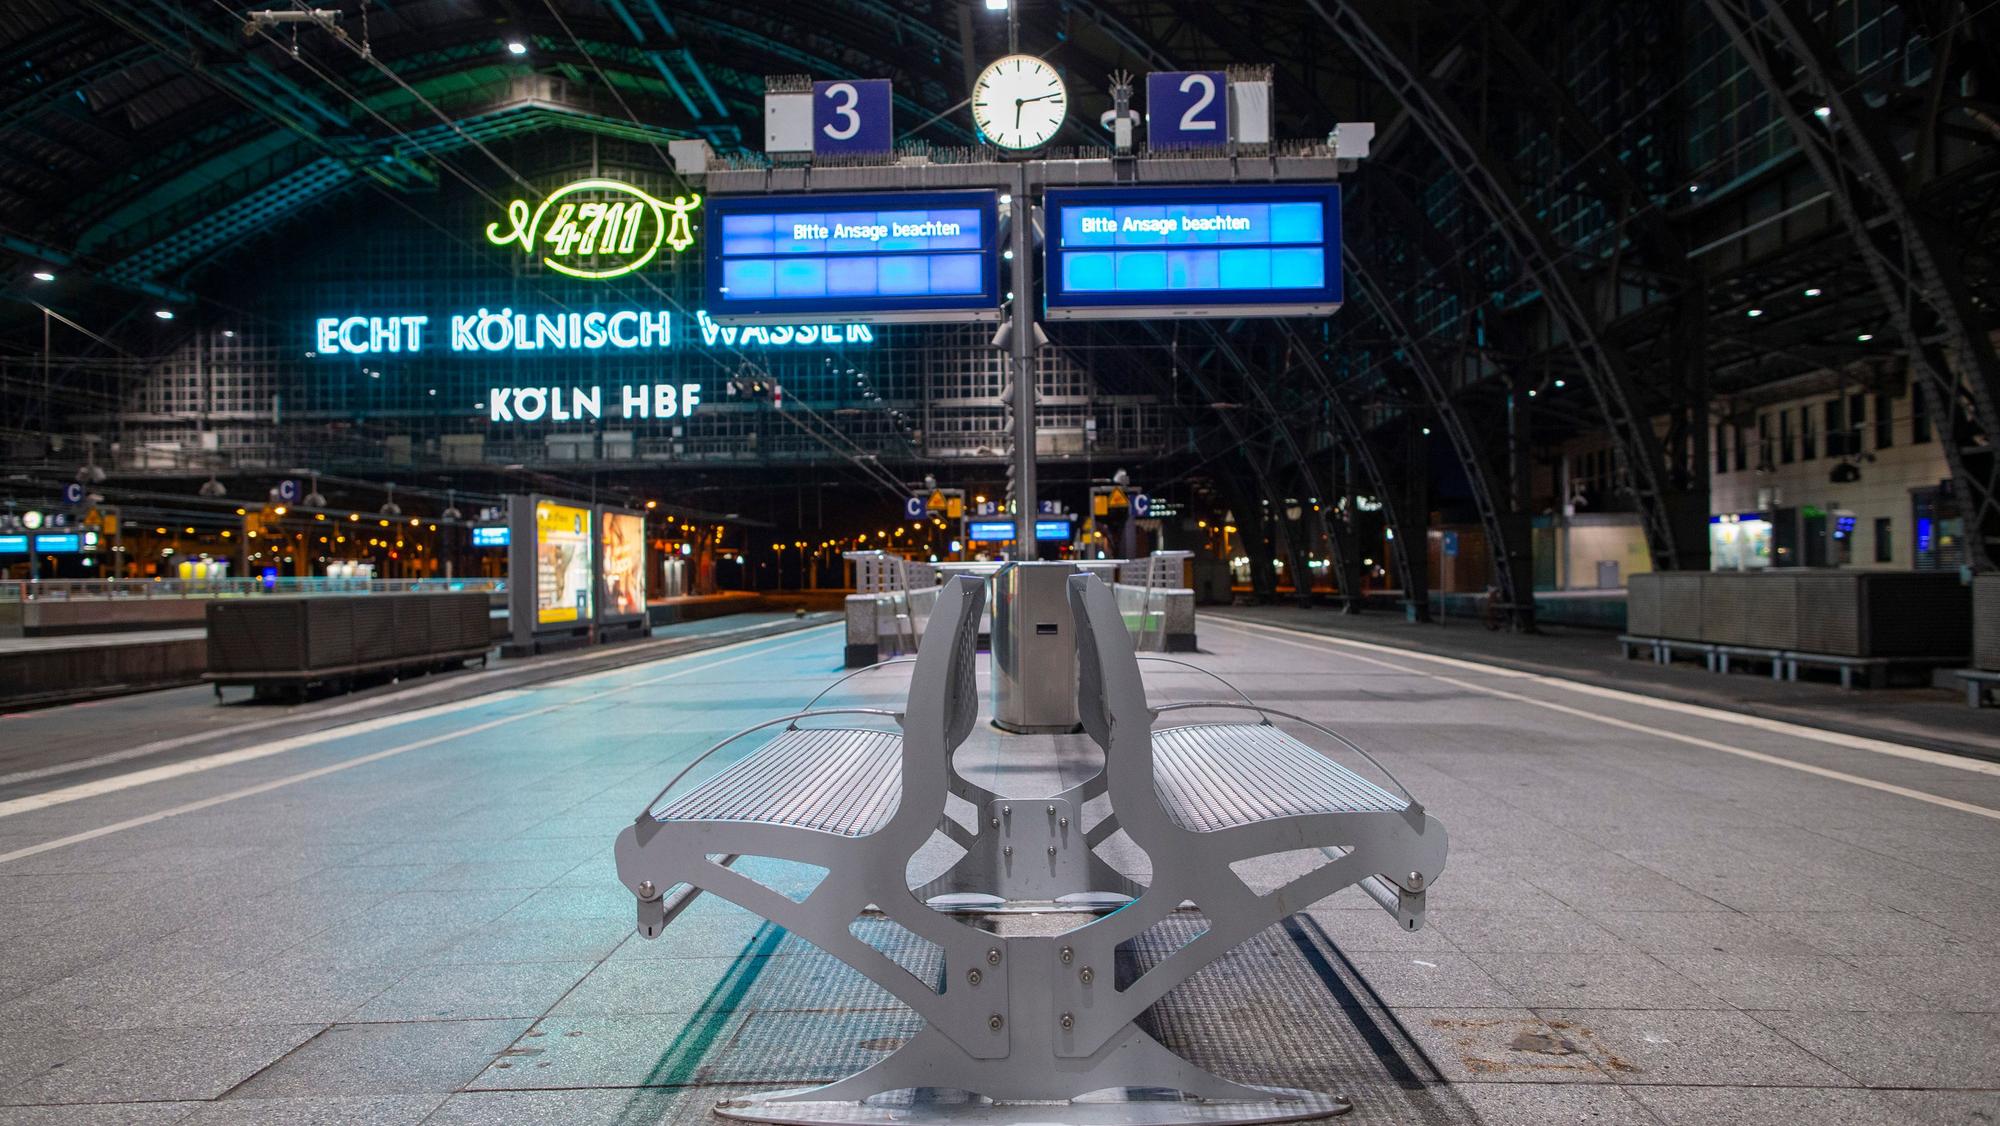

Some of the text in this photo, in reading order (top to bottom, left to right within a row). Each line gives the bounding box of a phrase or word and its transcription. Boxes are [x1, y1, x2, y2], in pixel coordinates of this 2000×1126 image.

[822, 83, 861, 140] 3
[1178, 75, 1217, 131] 2
[544, 202, 643, 255] 4711
[793, 220, 960, 242] Bitte Ansage beachten
[1082, 215, 1250, 235] Bitte Ansage beachten
[316, 316, 427, 355] ECHT
[450, 307, 671, 351] KÖLNISCH
[490, 383, 701, 422] KÖLN HBF
[67, 483, 81, 502] C
[280, 479, 294, 499] C
[907, 497, 921, 516] C
[986, 501, 996, 514] 3
[1043, 500, 1053, 513] 2
